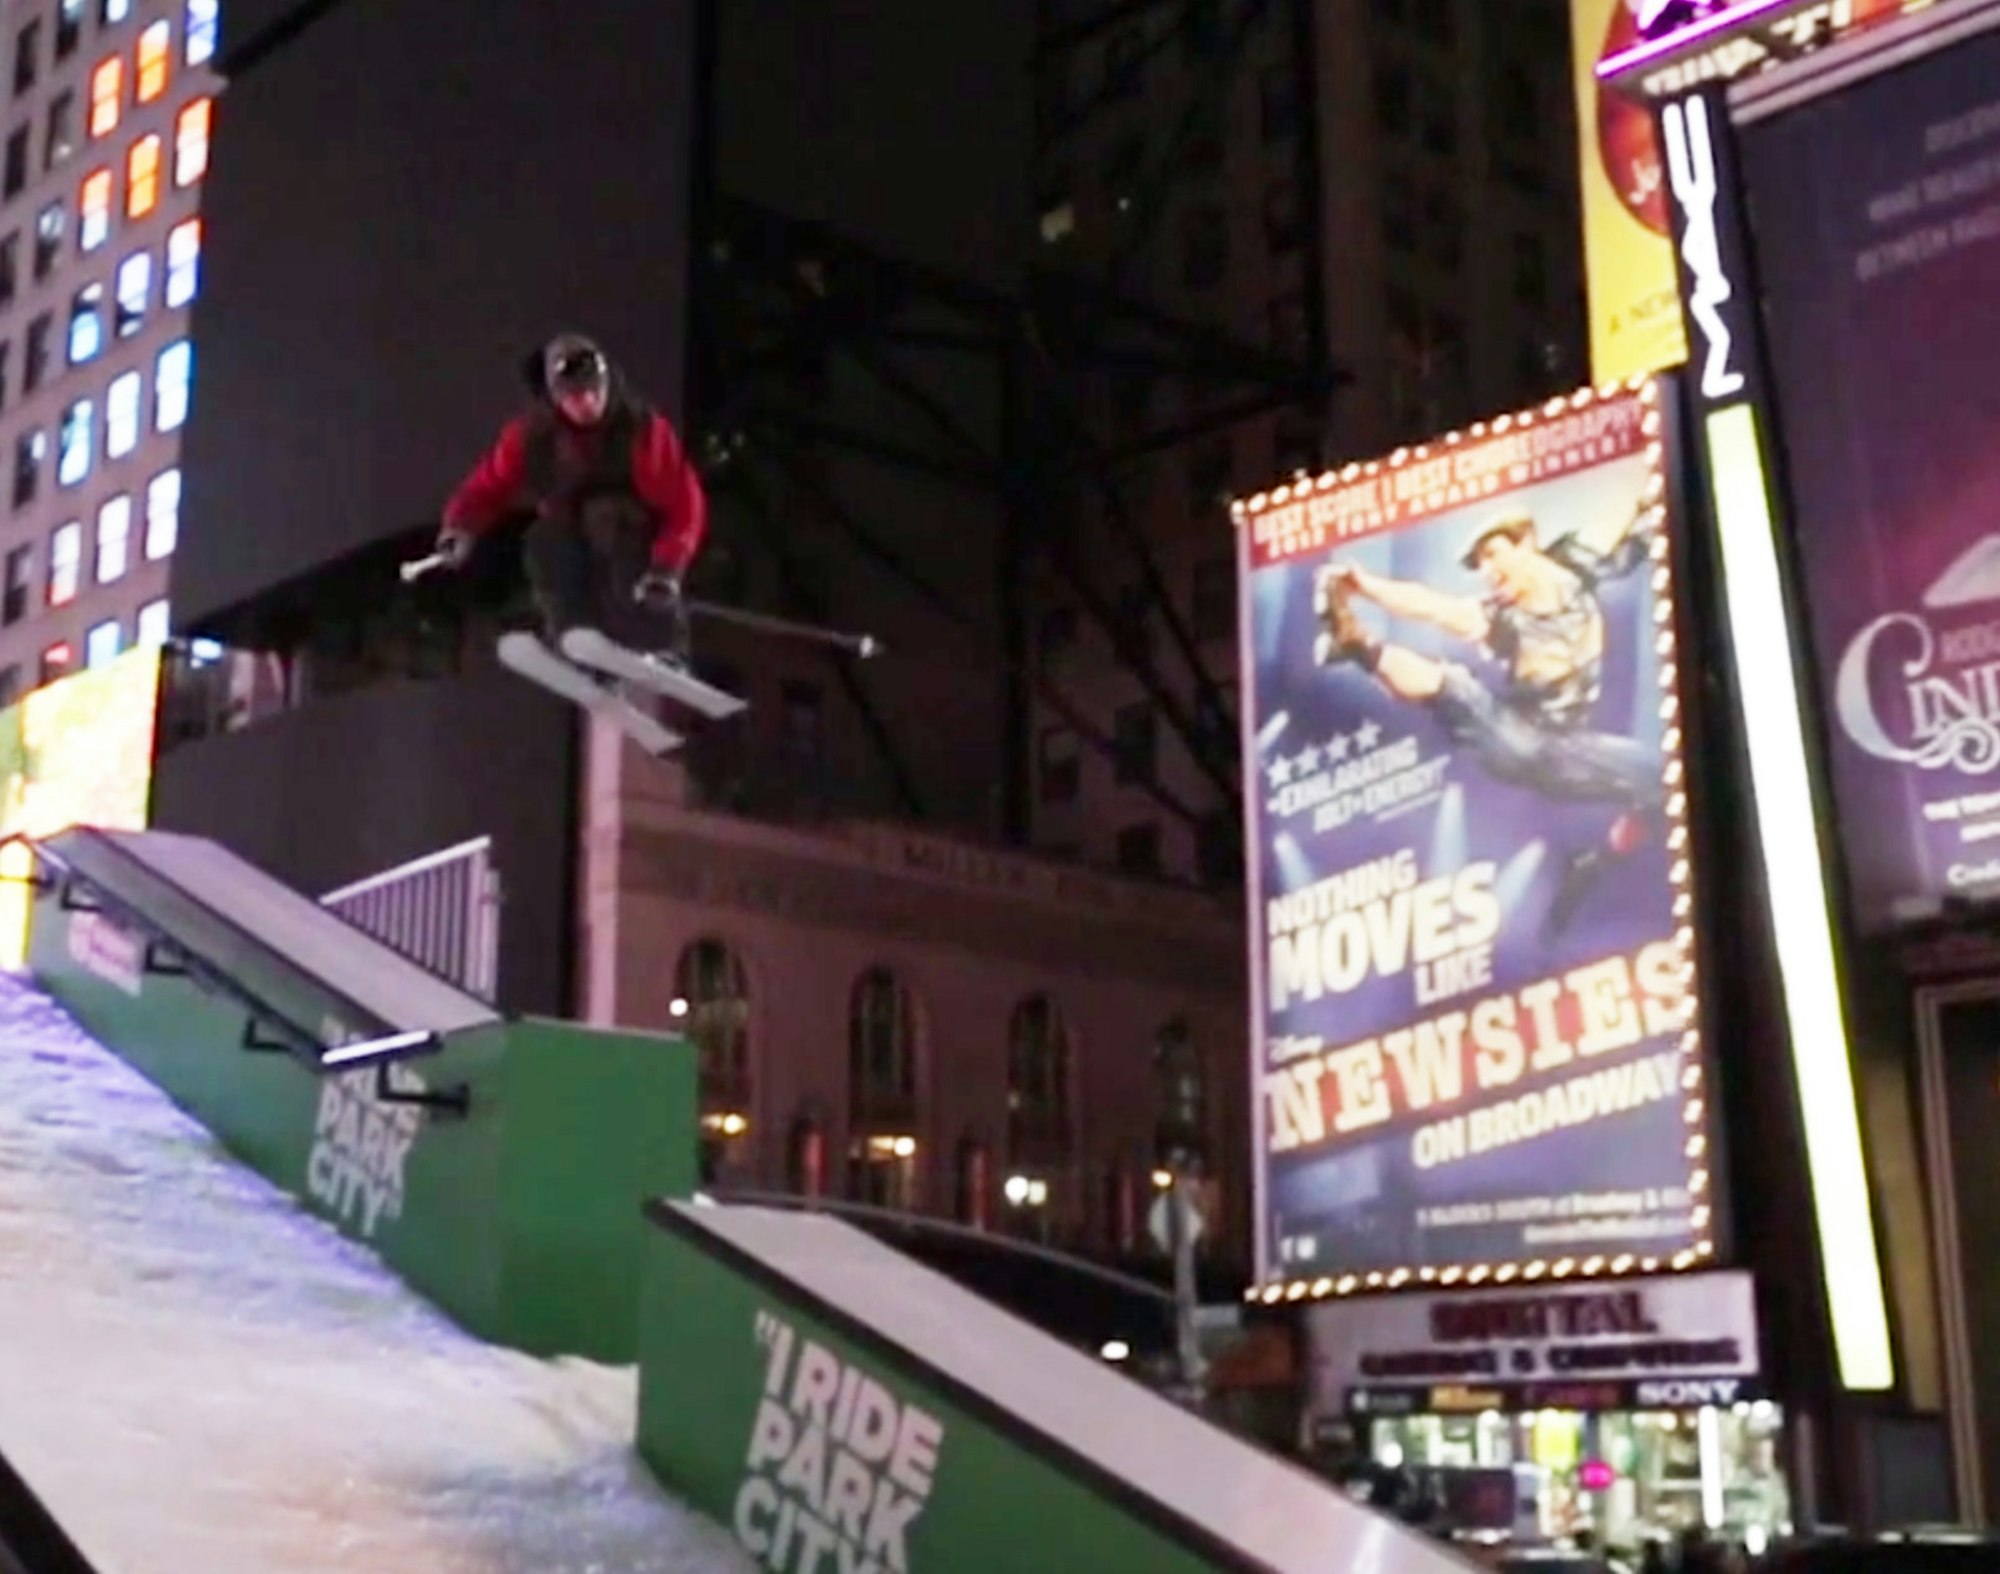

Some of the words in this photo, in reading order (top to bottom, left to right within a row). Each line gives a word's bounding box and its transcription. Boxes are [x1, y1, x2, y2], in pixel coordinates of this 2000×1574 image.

[1254, 503, 1303, 544] BEST
[1308, 479, 1377, 527] SCORE
[1268, 847, 1418, 937] NOTHING
[1269, 860, 1500, 1013] MOVES
[1414, 945, 1494, 1006] LIKE
[1264, 940, 1698, 1152] NEWSIES
[1412, 1117, 1468, 1170] ON
[1469, 1052, 1682, 1153] BROADWAY
[790, 1341, 944, 1498] RIDE
[1636, 1379, 1740, 1404] SONY
[747, 1398, 924, 1573] PARK
